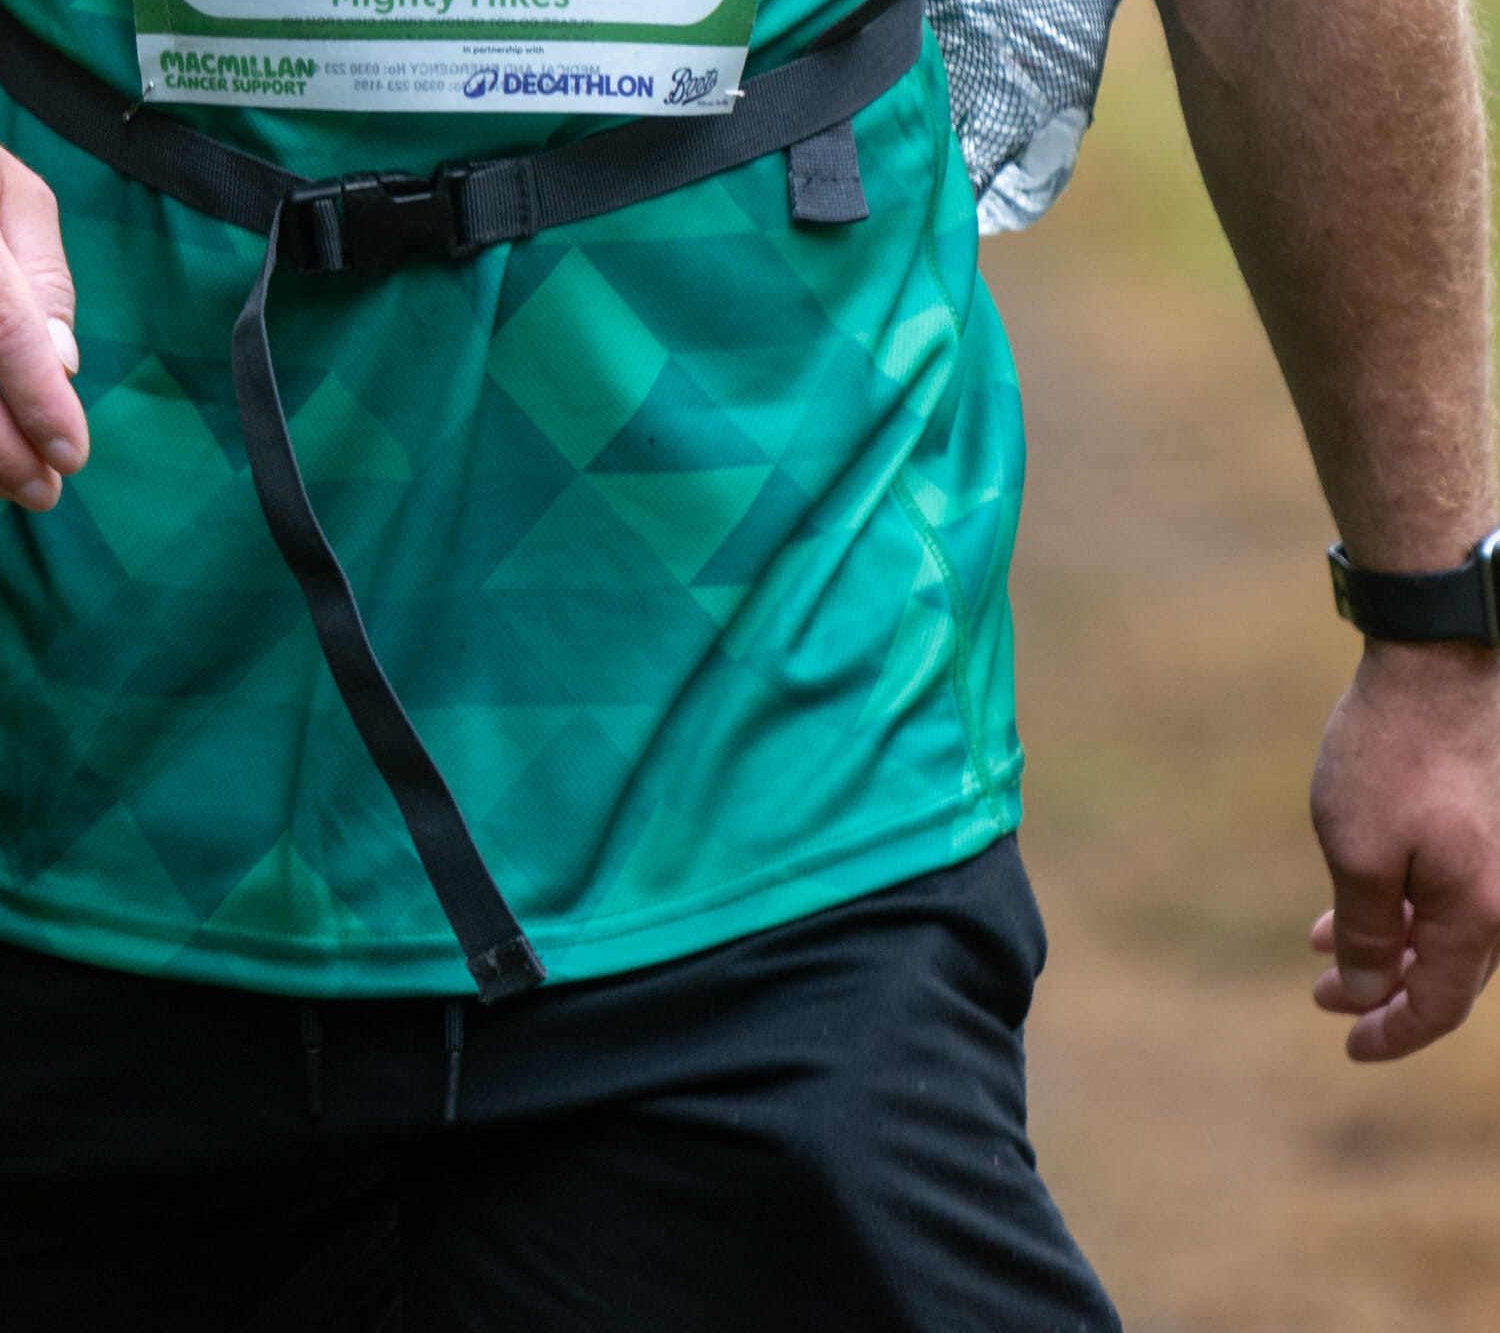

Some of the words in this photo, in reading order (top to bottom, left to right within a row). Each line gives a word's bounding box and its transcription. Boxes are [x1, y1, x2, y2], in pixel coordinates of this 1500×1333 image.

[473, 45, 523, 56] partnership
[525, 45, 544, 55] with
[160, 49, 315, 79] MACMILLAN
[165, 74, 229, 93] CANCER
[232, 78, 308, 96] SUPPORT
[503, 73, 654, 98] DECATHLON
[664, 68, 719, 106] Boots
